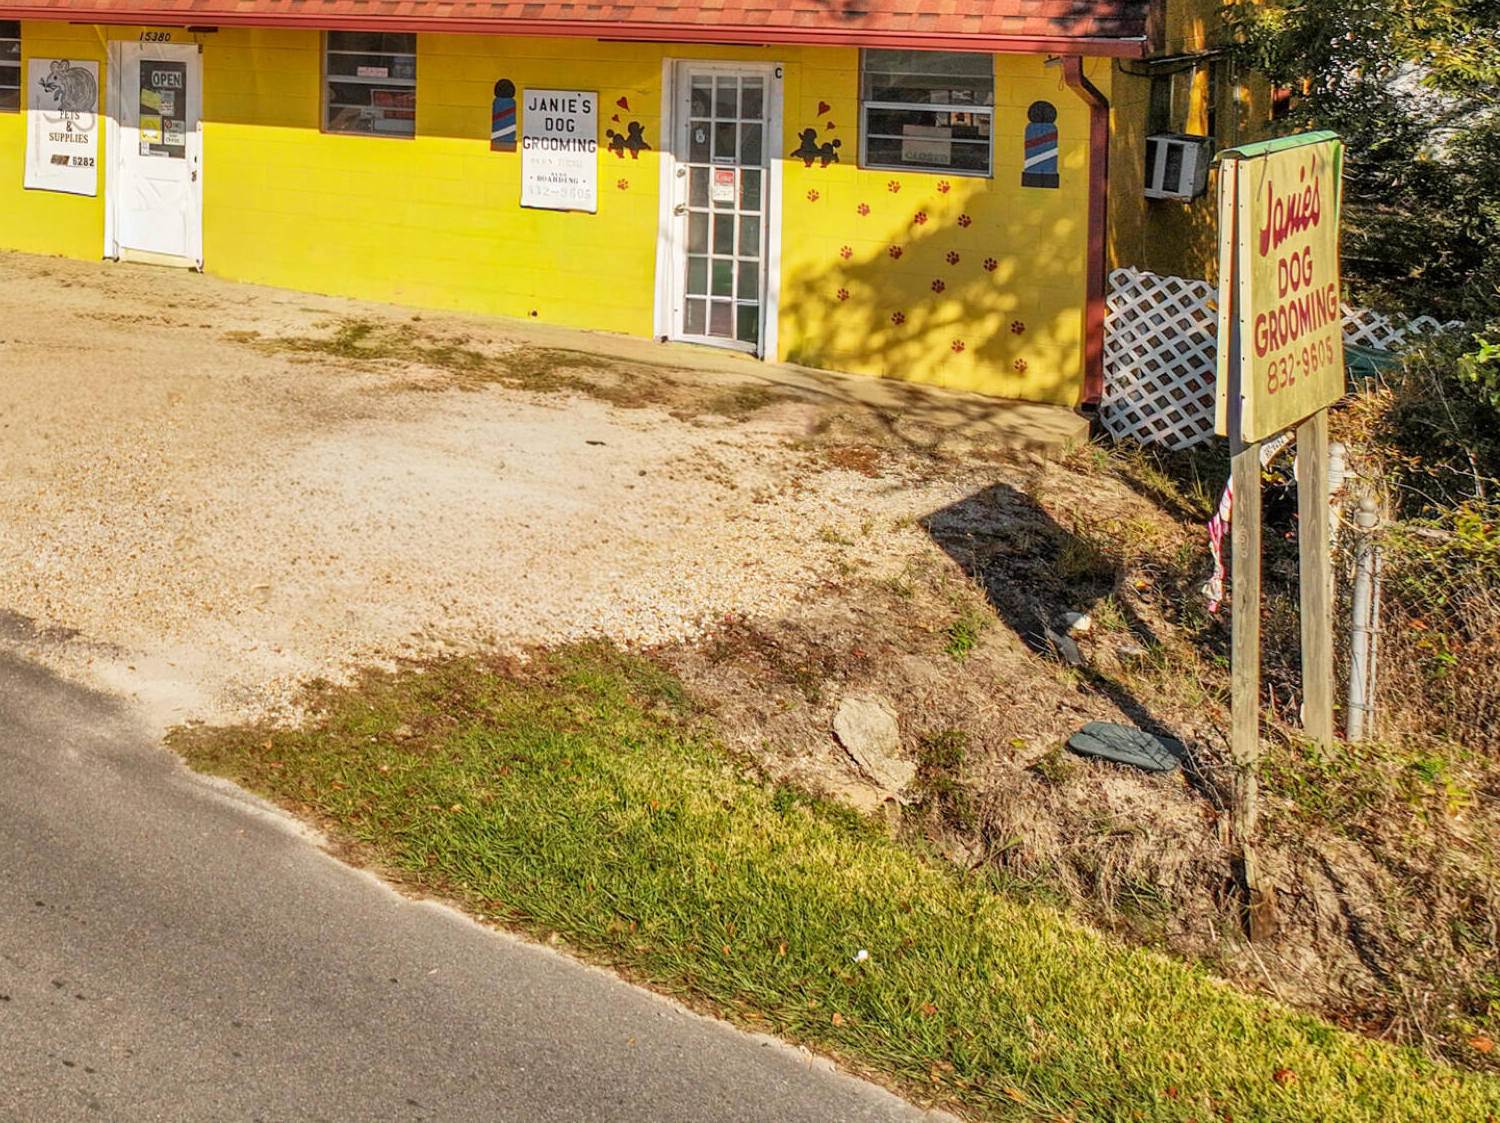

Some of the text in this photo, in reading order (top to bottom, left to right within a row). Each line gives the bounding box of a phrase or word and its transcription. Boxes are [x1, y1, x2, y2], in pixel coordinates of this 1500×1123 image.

[140, 31, 171, 42] 15380
[153, 72, 181, 86] OPEN
[775, 67, 783, 79] C
[528, 93, 592, 114] JANIE'S
[60, 110, 80, 120] PETS
[66, 120, 73, 133] &
[545, 117, 575, 133] DOG
[49, 132, 89, 144] SUPPLIES
[523, 136, 597, 154] GROOMING
[1259, 153, 1321, 258] Janie's
[1278, 245, 1313, 299] DOG
[1254, 283, 1338, 358] GROOMING
